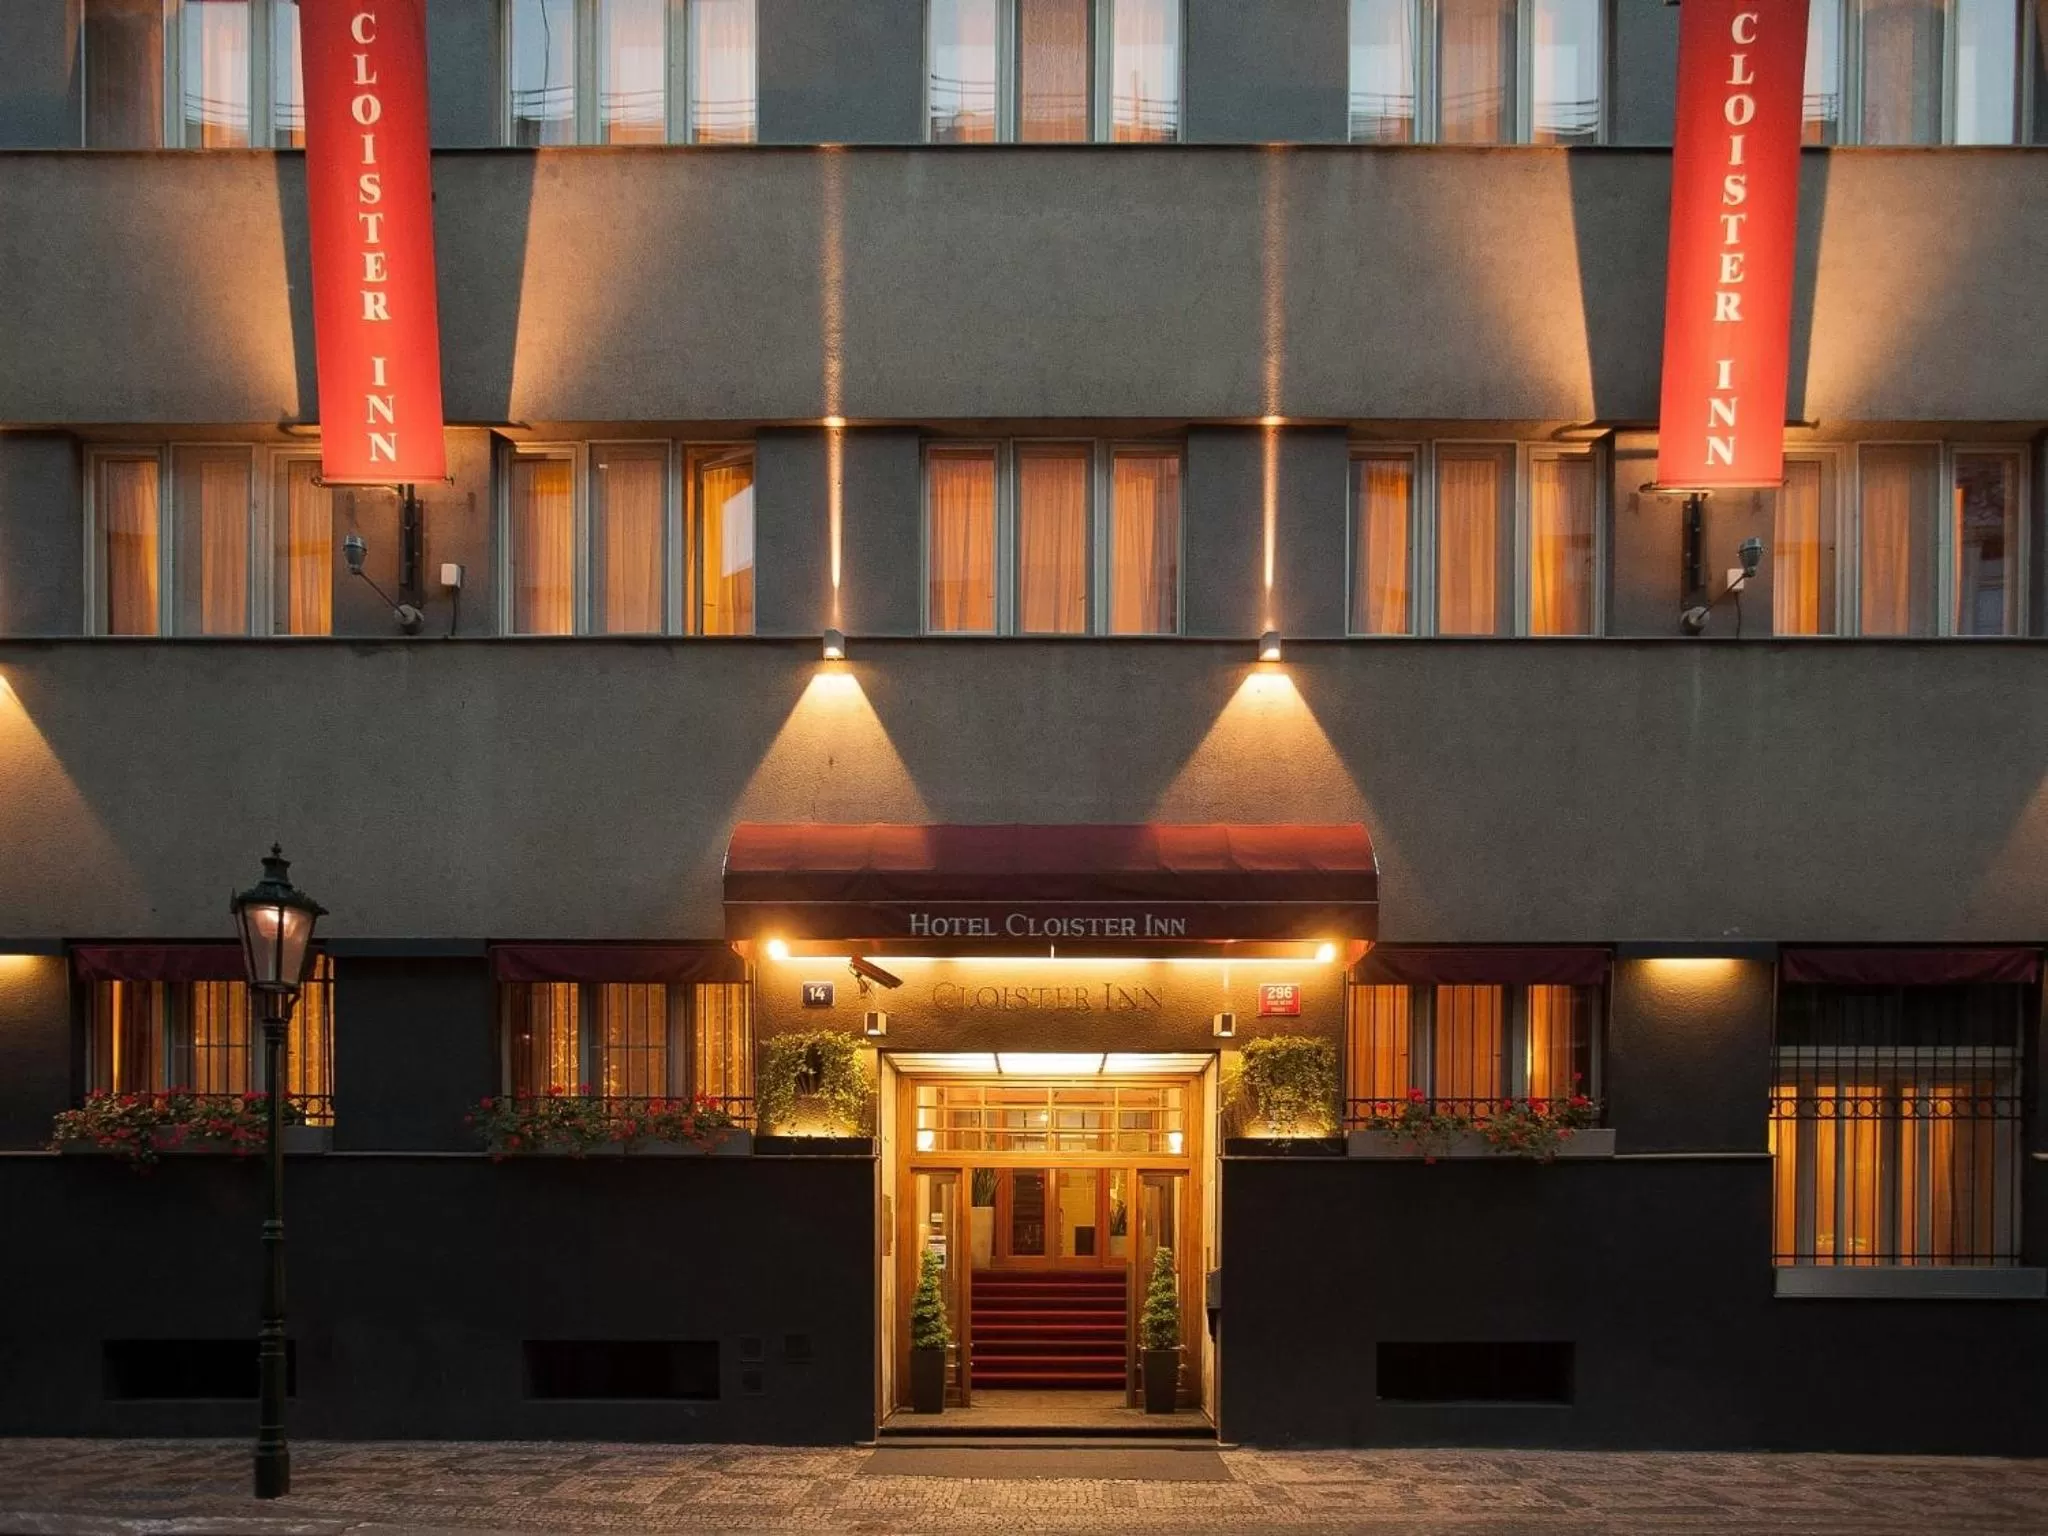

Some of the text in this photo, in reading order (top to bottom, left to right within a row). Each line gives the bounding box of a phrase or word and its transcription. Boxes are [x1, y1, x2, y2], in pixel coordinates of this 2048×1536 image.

[351, 12, 398, 462] CLOISTER INN
[1704, 13, 1758, 466] CLOISTER INN
[909, 913, 1186, 936] HOTEL CLOISTER INN
[809, 986, 826, 1001] 14
[932, 981, 1164, 1010] CLOISTER INN
[1267, 986, 1293, 1000] 296
